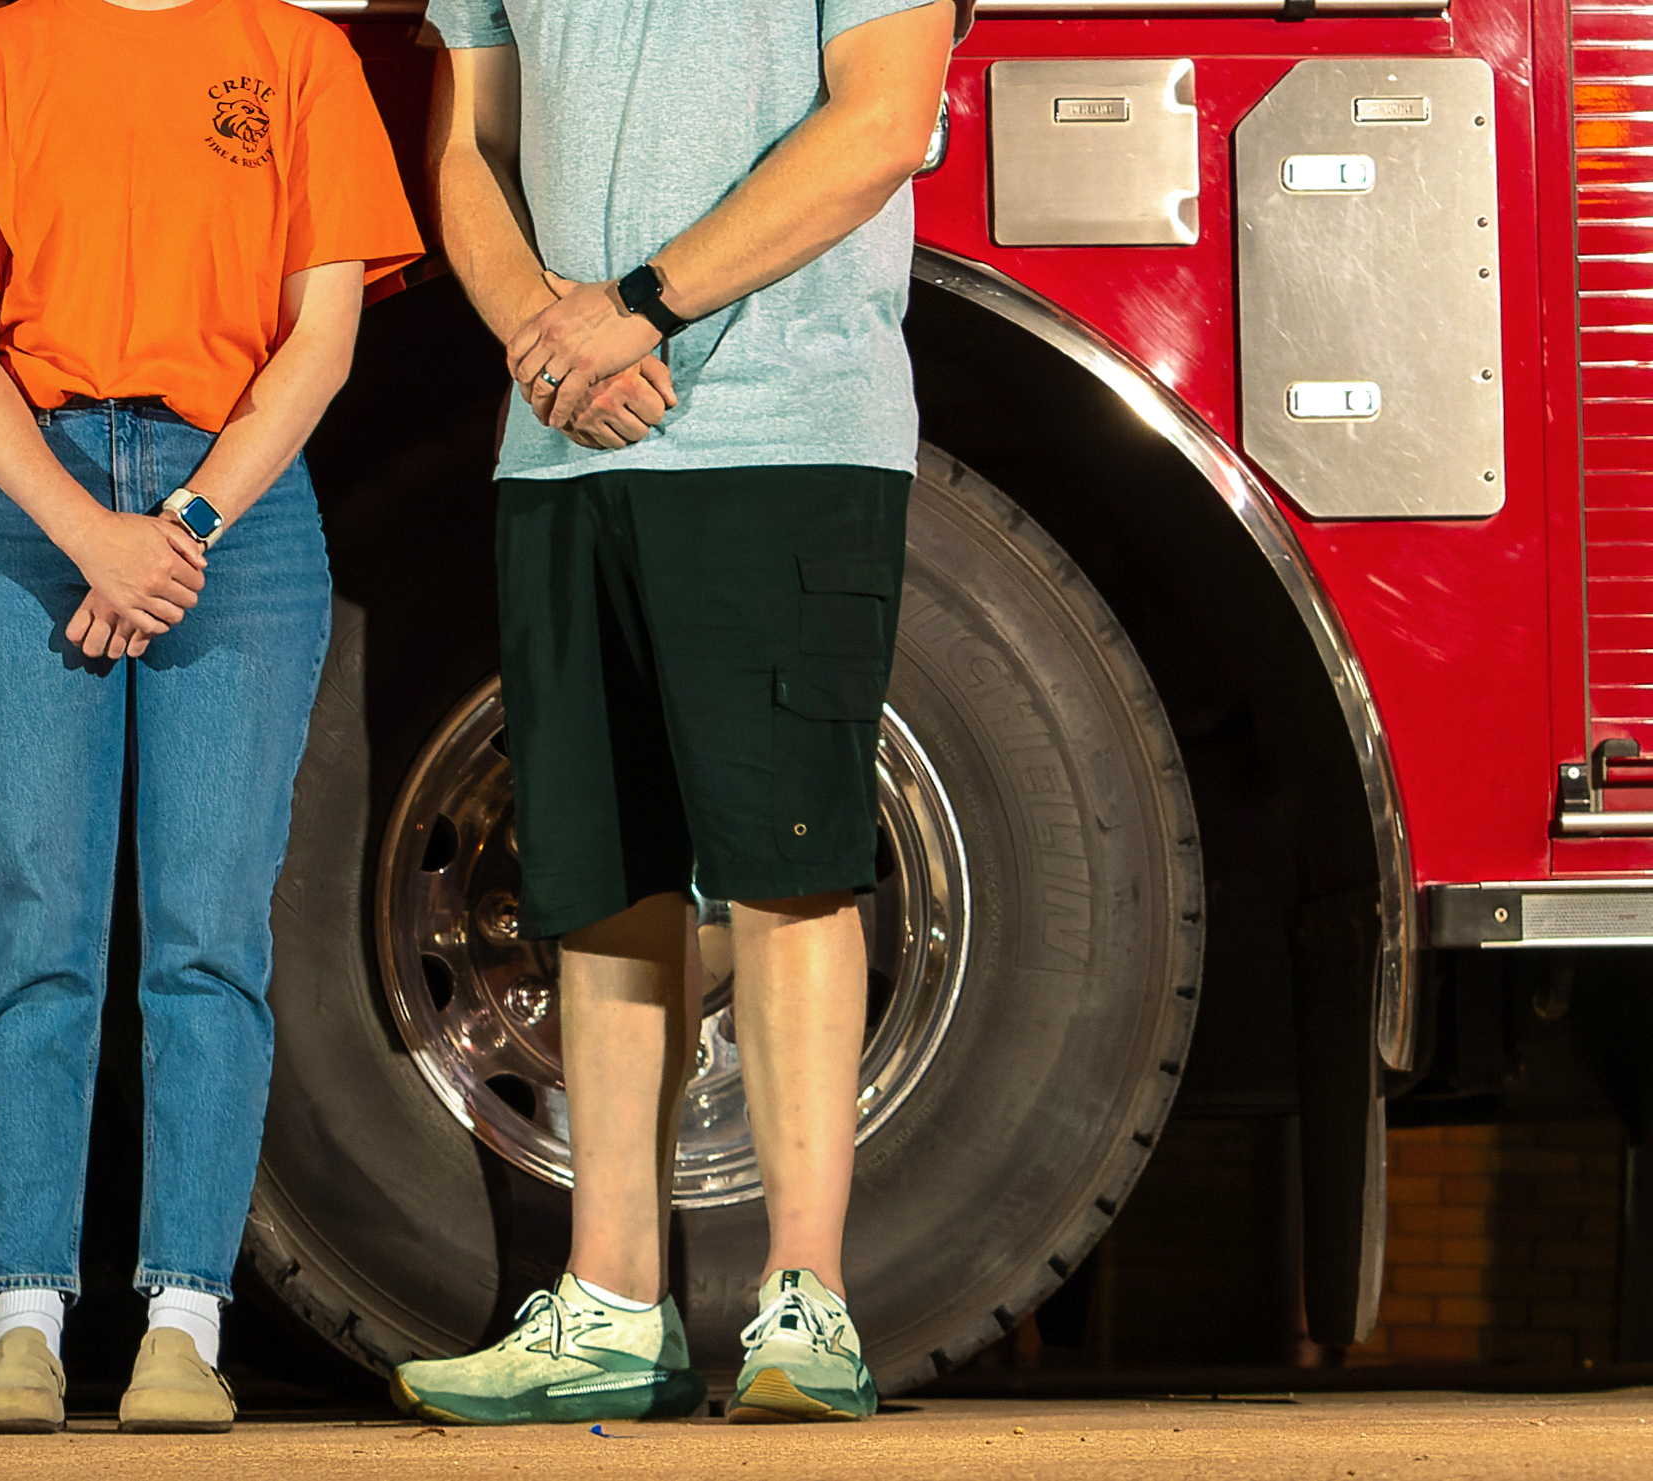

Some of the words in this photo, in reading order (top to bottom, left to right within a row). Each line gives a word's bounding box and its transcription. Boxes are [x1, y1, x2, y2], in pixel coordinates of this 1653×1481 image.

[208, 76, 276, 102] CRETE
[205, 136, 229, 158] FIRE
[230, 155, 239, 164] &
